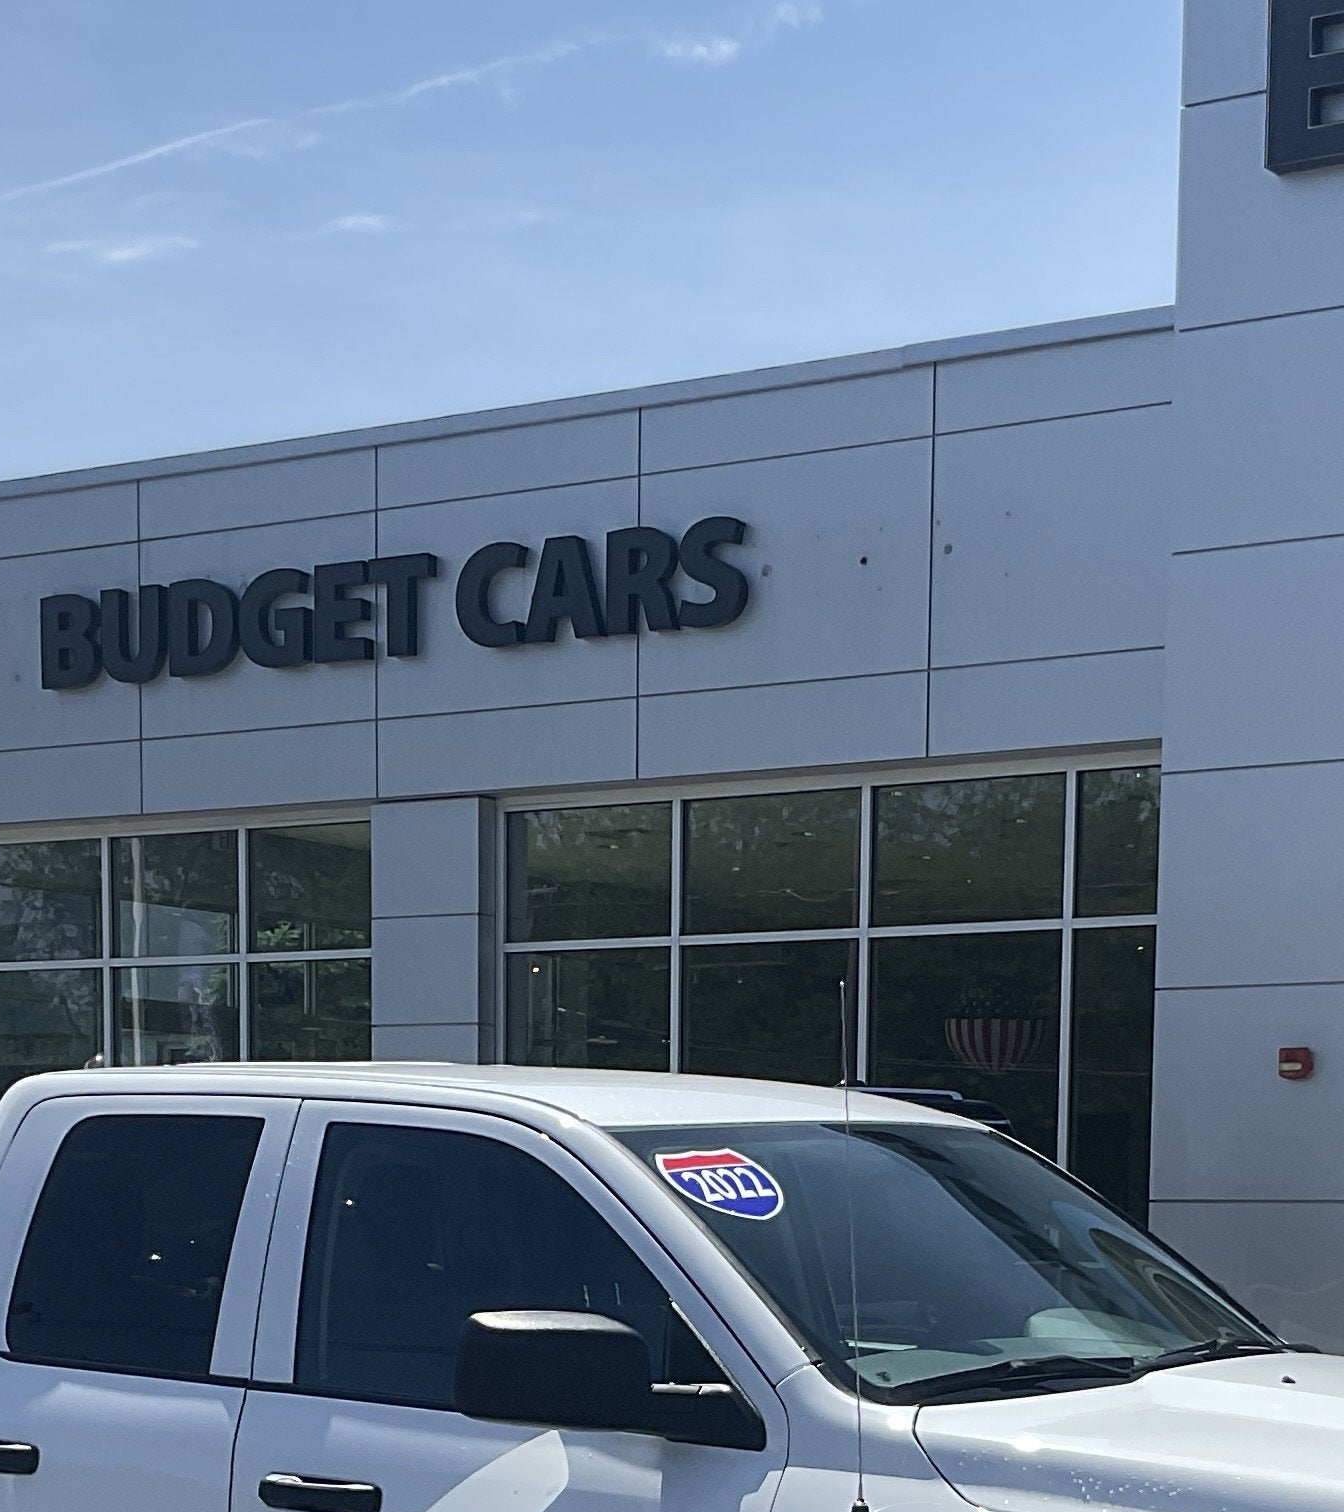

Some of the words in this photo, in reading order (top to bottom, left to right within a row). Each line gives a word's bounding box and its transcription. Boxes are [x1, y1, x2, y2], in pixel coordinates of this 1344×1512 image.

[40, 552, 438, 690] BUDGET
[455, 515, 749, 649] CARS
[680, 1167, 777, 1203] 2022
